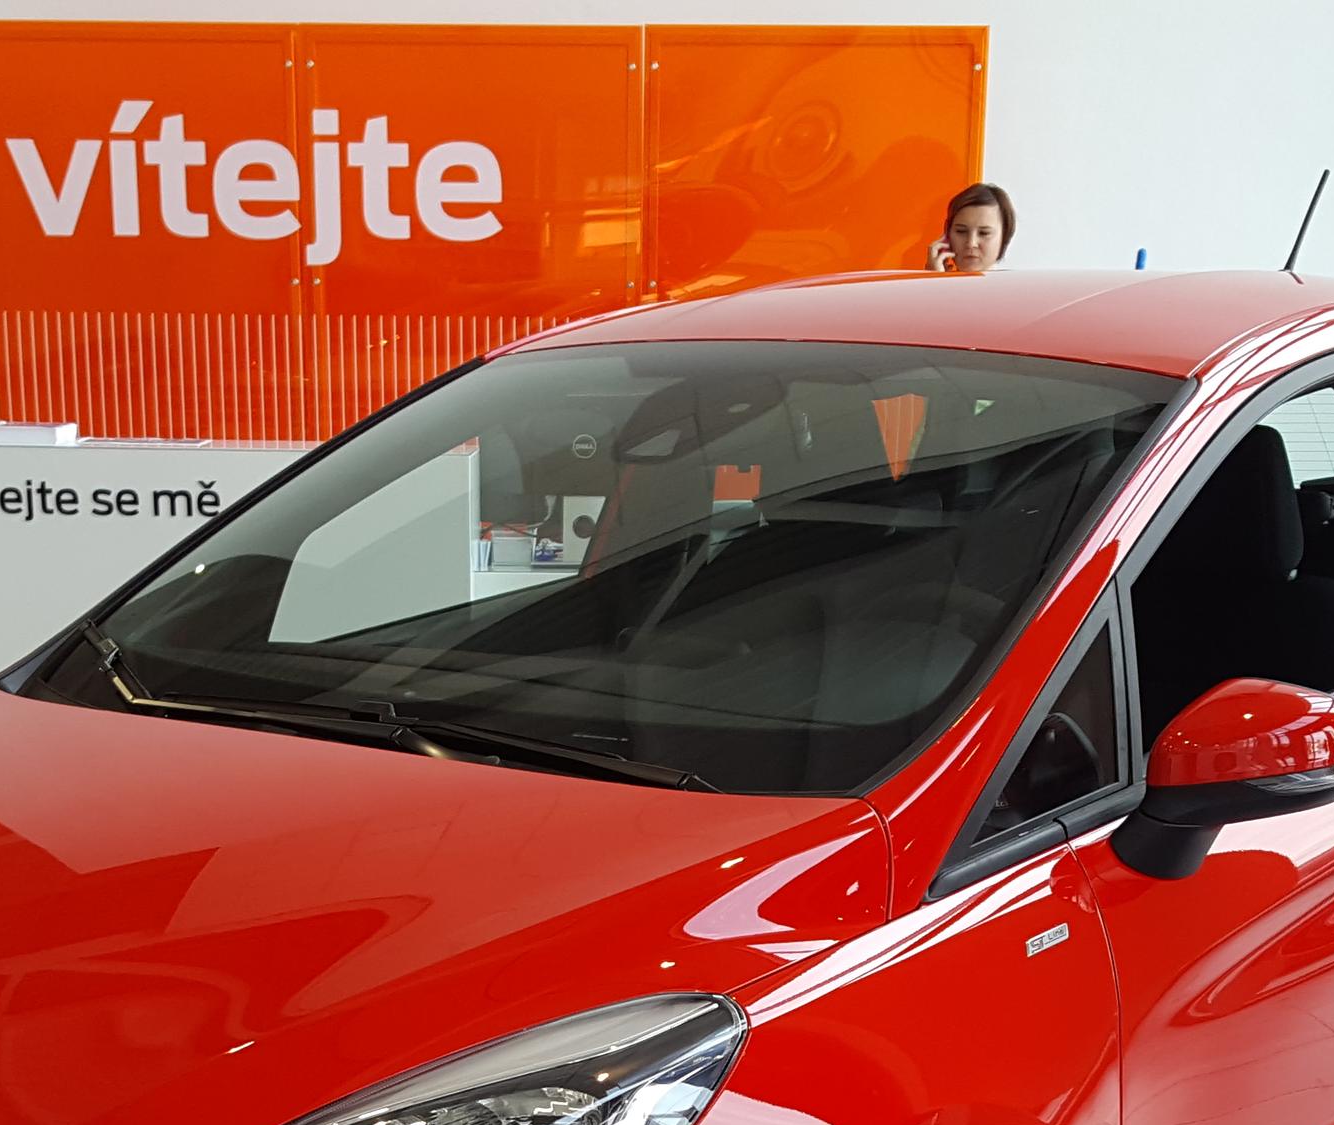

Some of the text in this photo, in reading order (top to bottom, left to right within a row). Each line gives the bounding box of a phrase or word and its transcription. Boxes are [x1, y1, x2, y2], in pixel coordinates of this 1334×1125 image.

[5, 100, 504, 266] vítejte
[92, 489, 140, 516] se
[153, 480, 221, 517] mě
